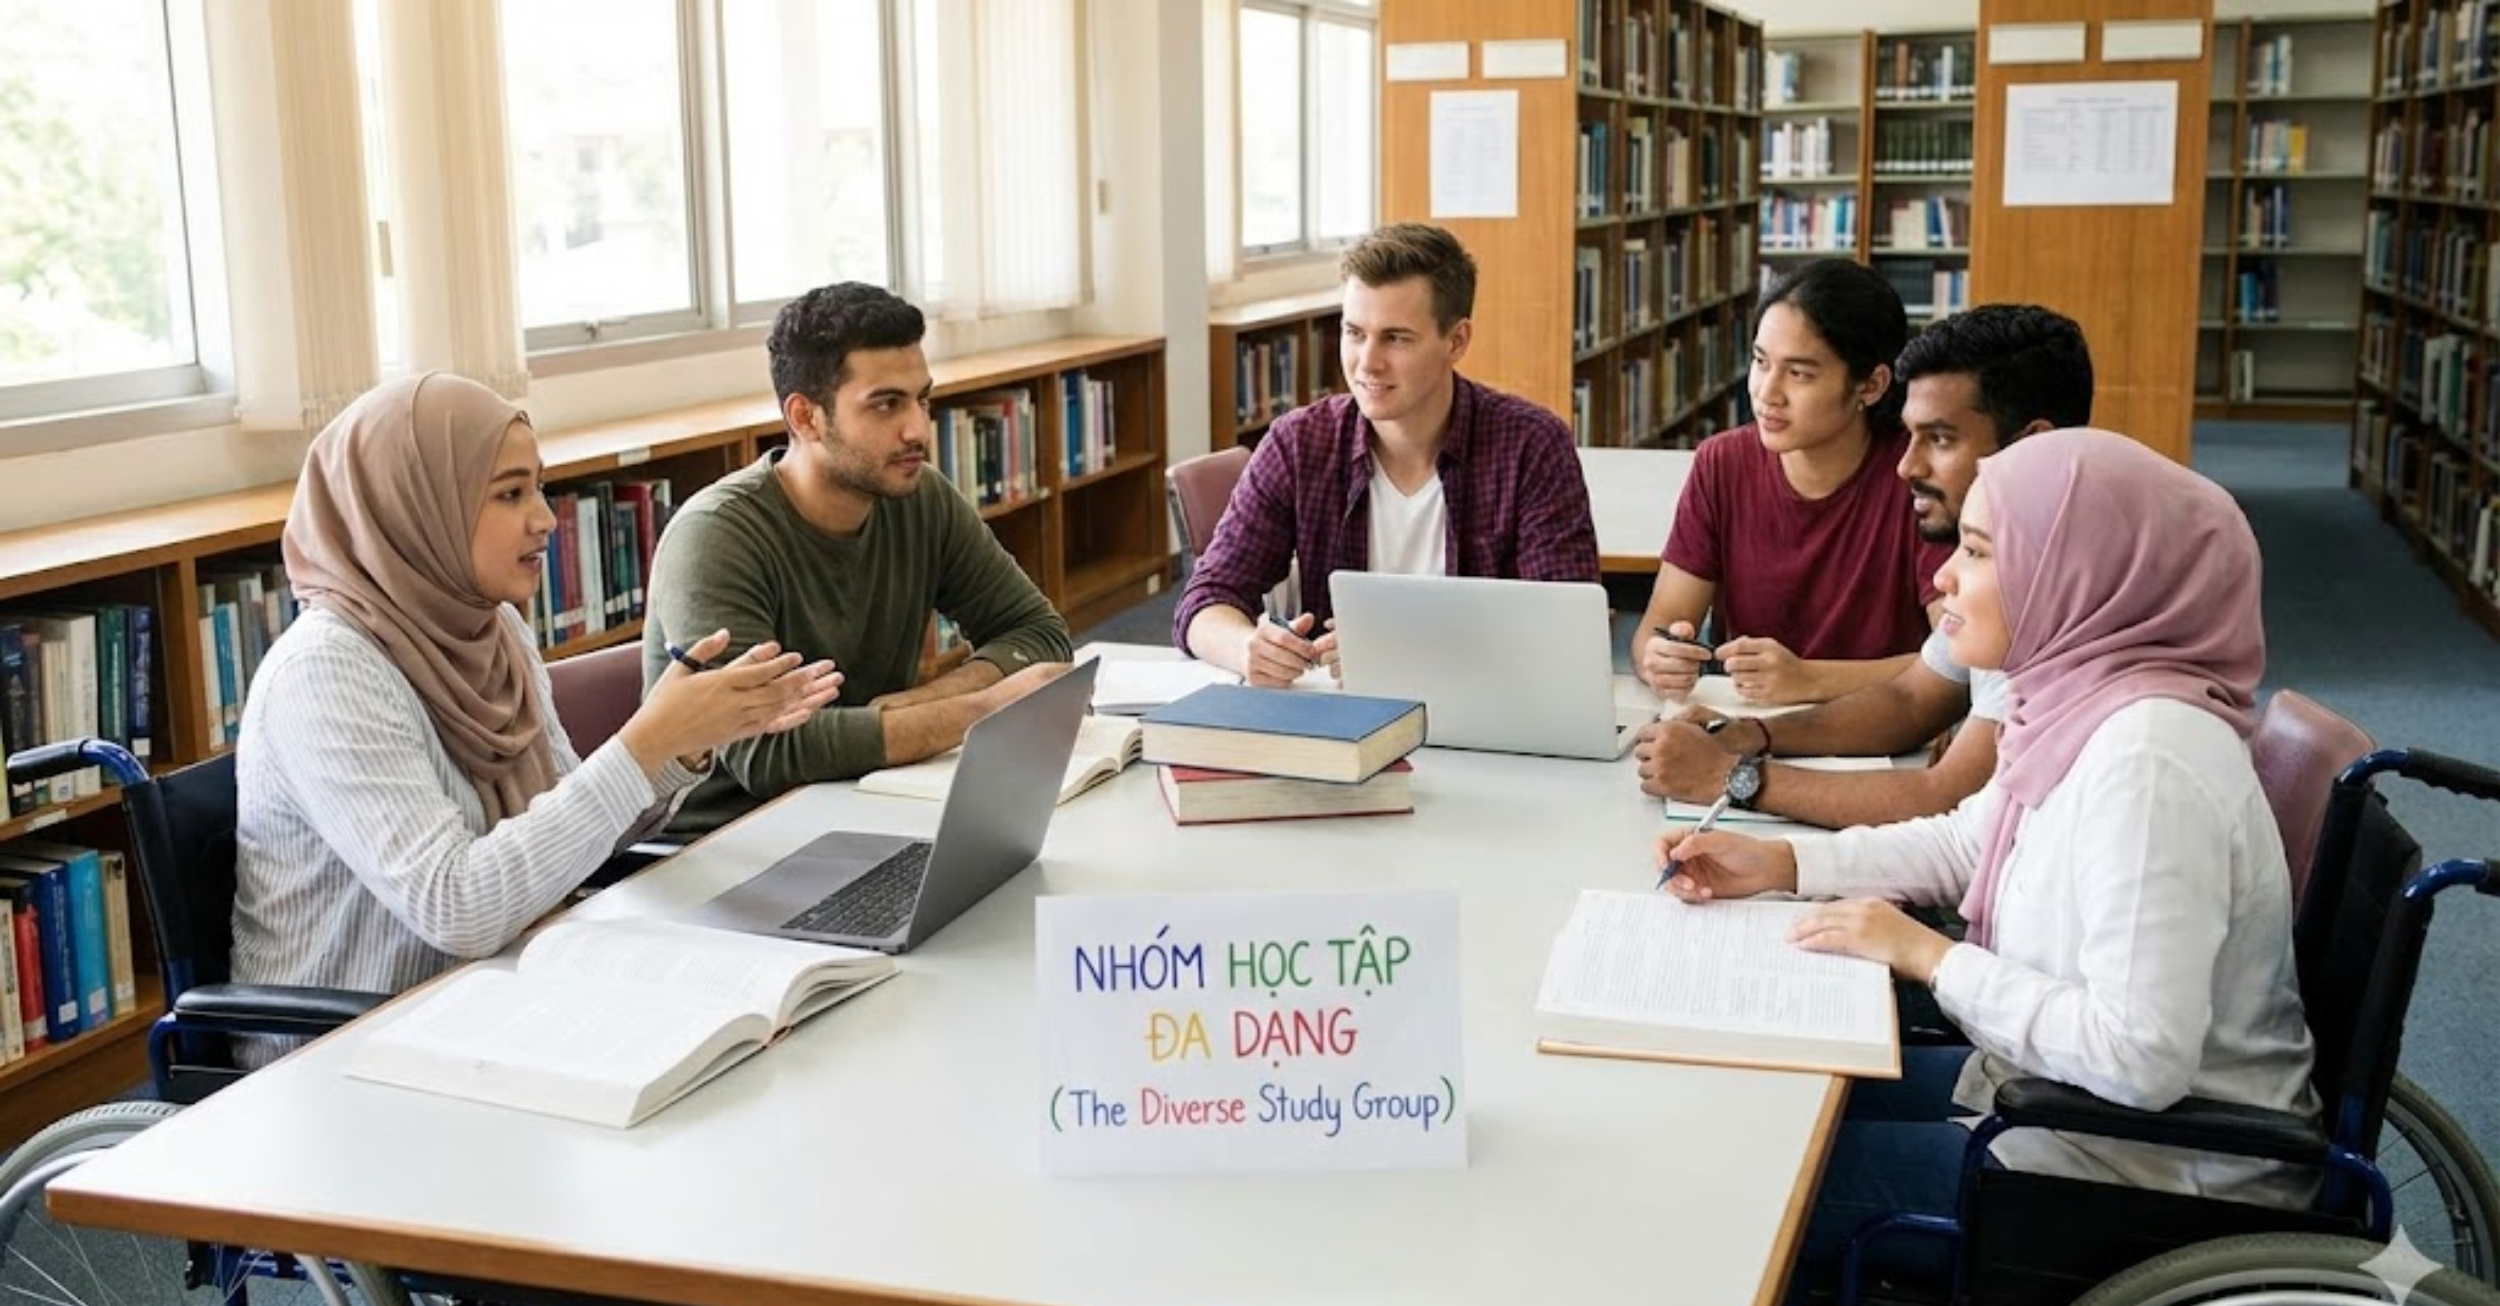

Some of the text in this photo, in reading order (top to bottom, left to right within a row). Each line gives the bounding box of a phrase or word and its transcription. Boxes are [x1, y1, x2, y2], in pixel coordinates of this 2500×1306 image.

[1075, 923, 1411, 998] NHÓM HỌC TẬP
[1145, 1007, 1359, 1069] ĐA DẠNG
[1050, 1075, 1457, 1139] (The Diverse Study Group)
